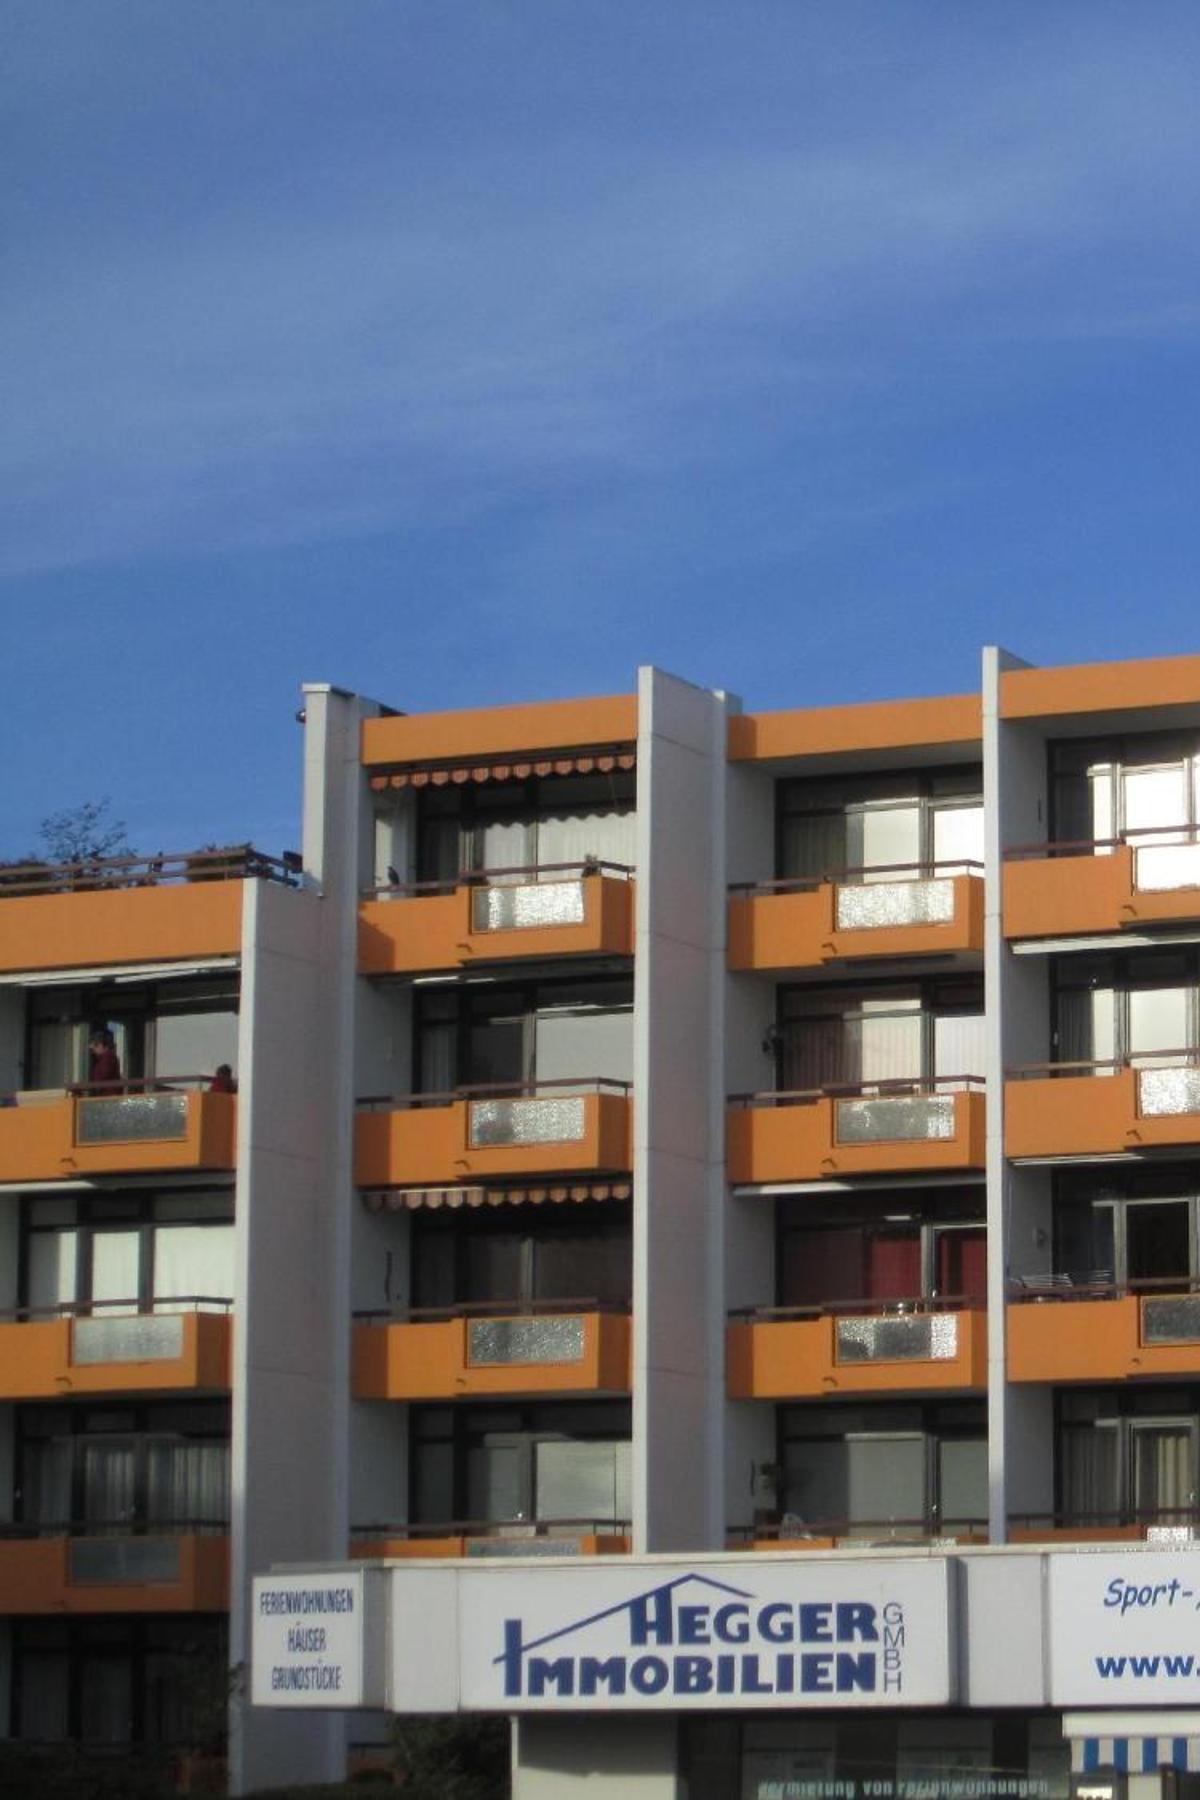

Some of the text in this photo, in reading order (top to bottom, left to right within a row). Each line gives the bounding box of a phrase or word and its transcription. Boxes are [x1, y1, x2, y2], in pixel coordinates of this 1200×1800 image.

[260, 1588, 354, 1616] FERIENWOHNUNGEN
[629, 1586, 880, 1647] HEGGER
[287, 1621, 327, 1653] HÄUSER
[504, 1619, 877, 1697] IMMOBILIEN
[271, 1659, 342, 1691] GRUNDSTÜCKE
